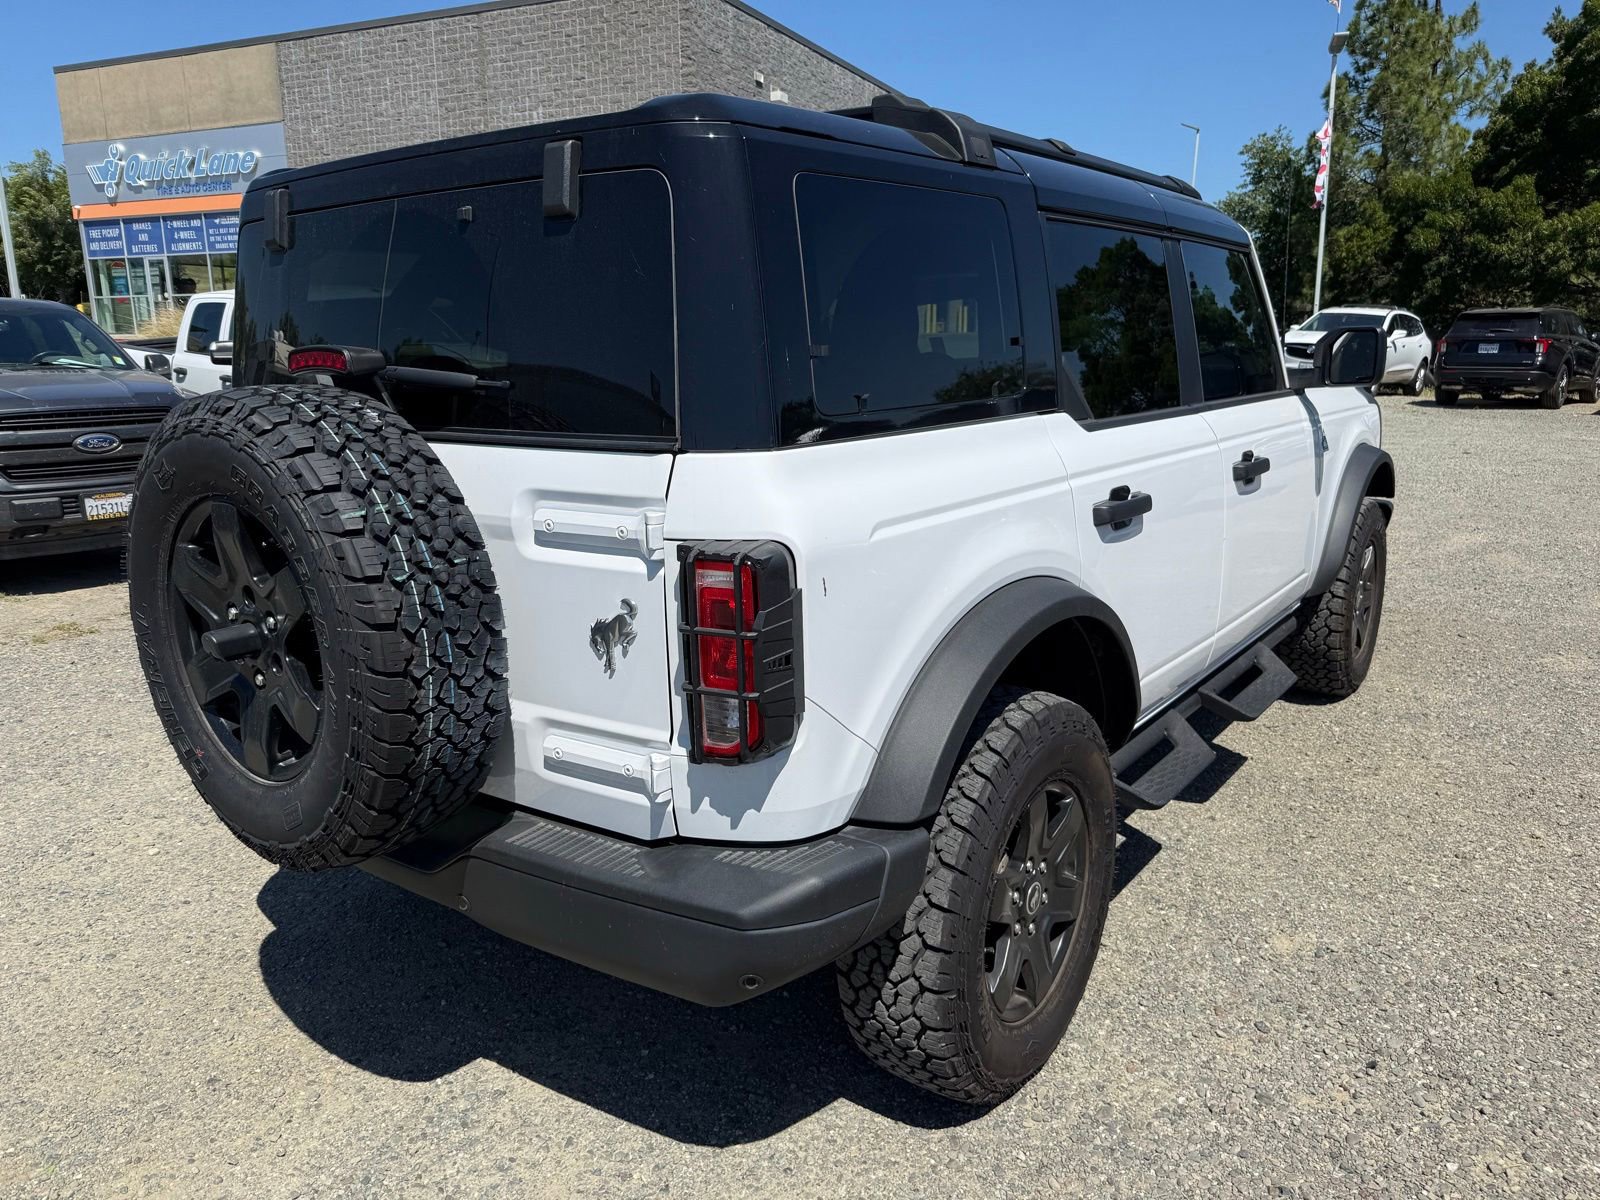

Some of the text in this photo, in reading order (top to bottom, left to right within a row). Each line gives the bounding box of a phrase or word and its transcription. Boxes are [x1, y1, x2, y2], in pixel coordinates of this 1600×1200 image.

[124, 147, 257, 186] Quick Lane
[156, 185, 173, 196] TIRE
[181, 184, 201, 194] AUTO
[203, 181, 232, 192] CENTER
[132, 222, 152, 231] BRAKES
[167, 218, 201, 229] 2-WHEEL AND
[89, 228, 119, 239] FREE PICKUP
[138, 233, 149, 242] AND
[174, 230, 197, 239] 4-WHEEL
[89, 240, 123, 251] AND DELIVERY
[131, 244, 158, 253] BATTERIES
[171, 241, 203, 251] ALIGNMENTS
[87, 438, 110, 448] Ford
[88, 501, 129, 516] 21531L
